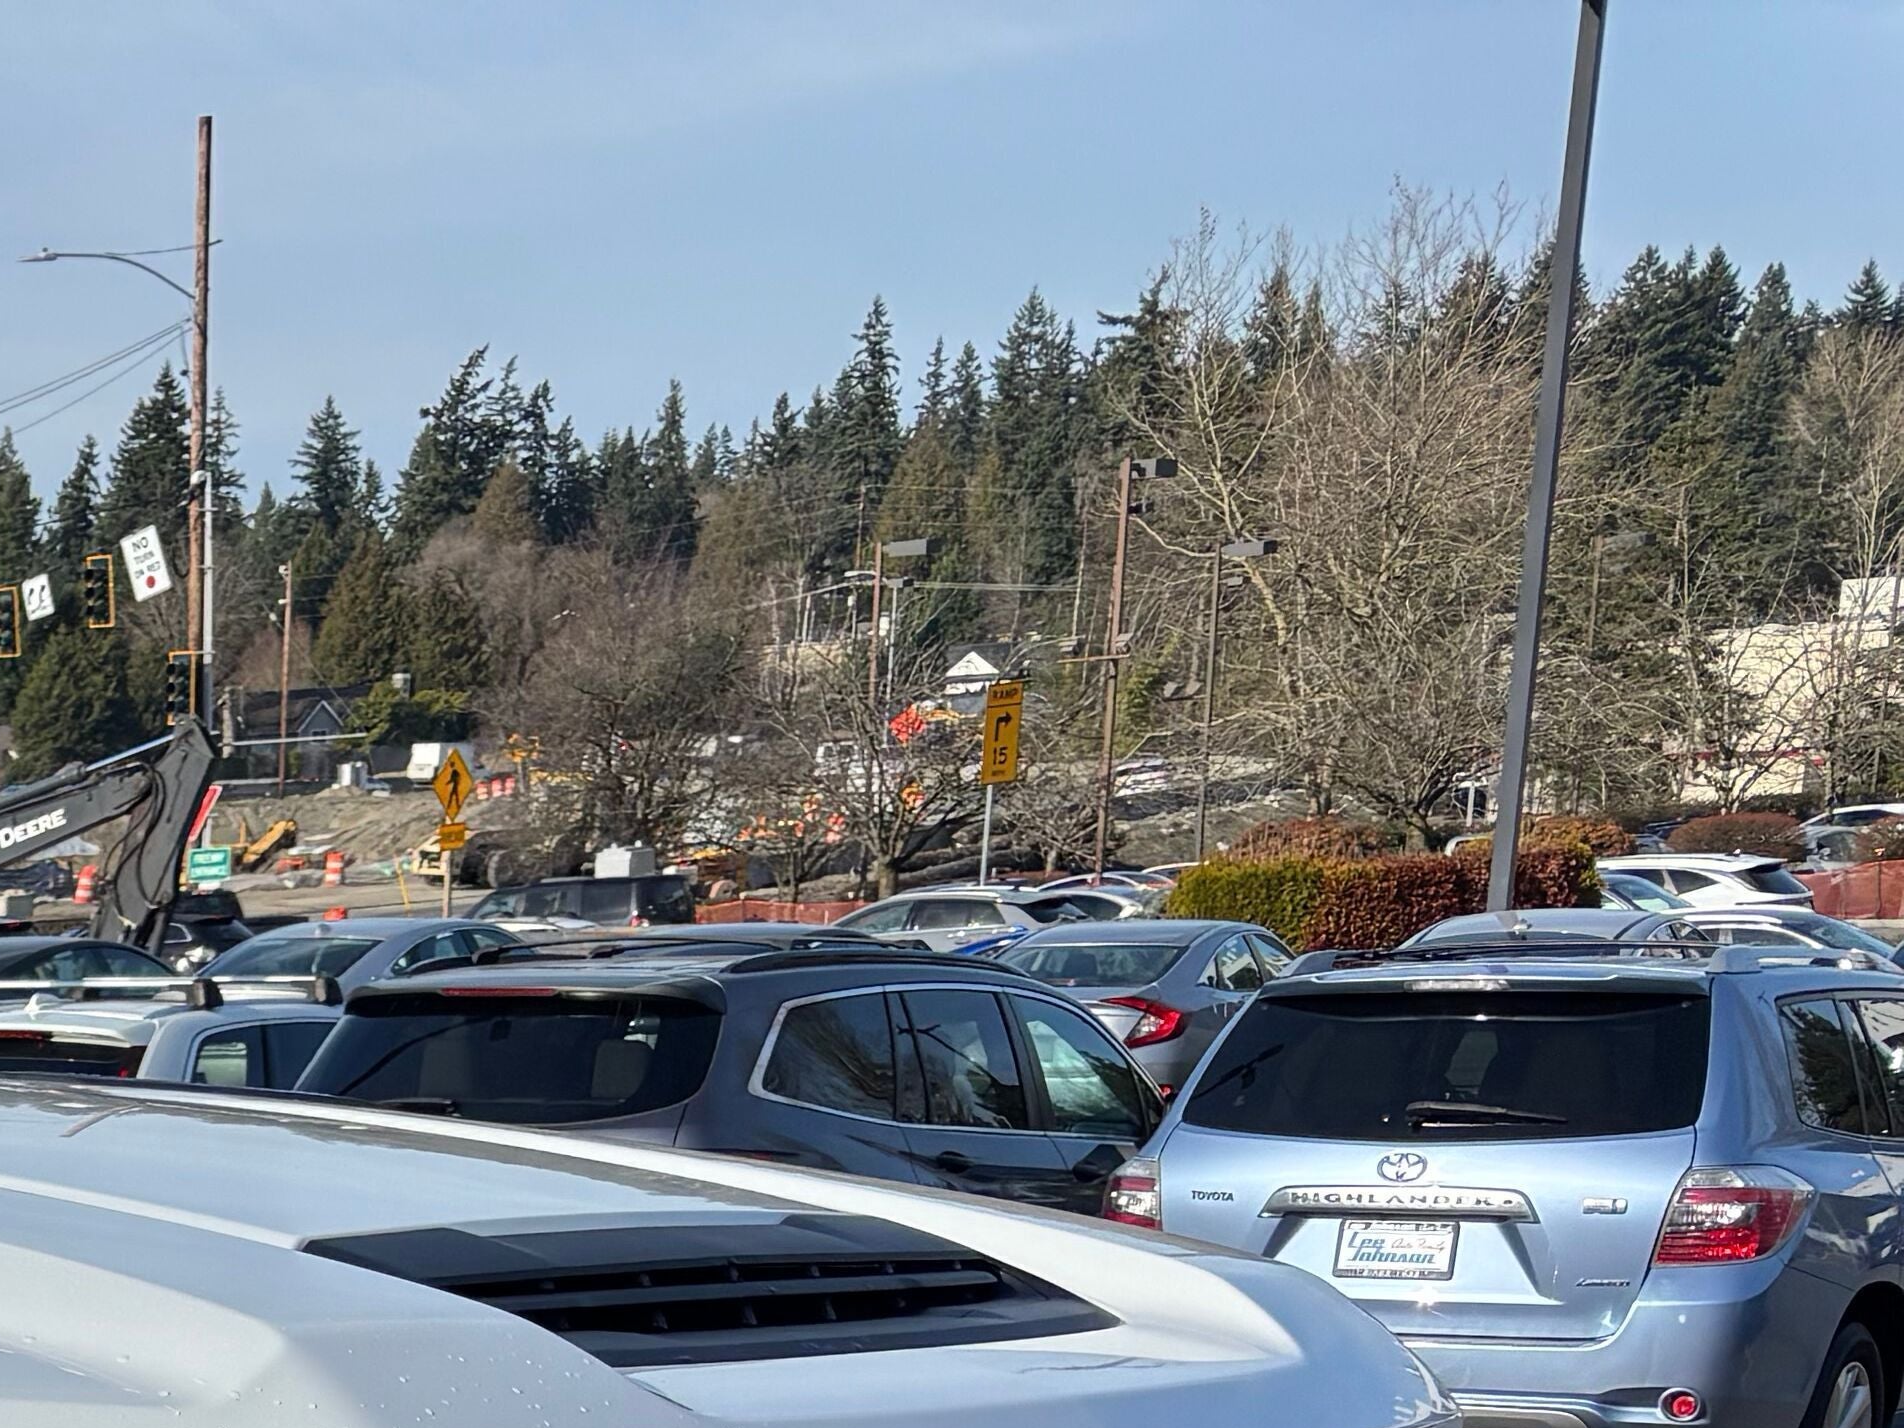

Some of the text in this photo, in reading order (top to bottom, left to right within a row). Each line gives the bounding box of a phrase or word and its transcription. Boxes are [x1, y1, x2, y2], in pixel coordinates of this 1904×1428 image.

[131, 536, 149, 552] NO
[993, 746, 1008, 766] 15
[1191, 1190, 1234, 1202] TOYOTA
[1292, 1192, 1493, 1206] HIGHLANDER
[1347, 1231, 1386, 1249] Lee
[1347, 1248, 1436, 1264] Johnson
